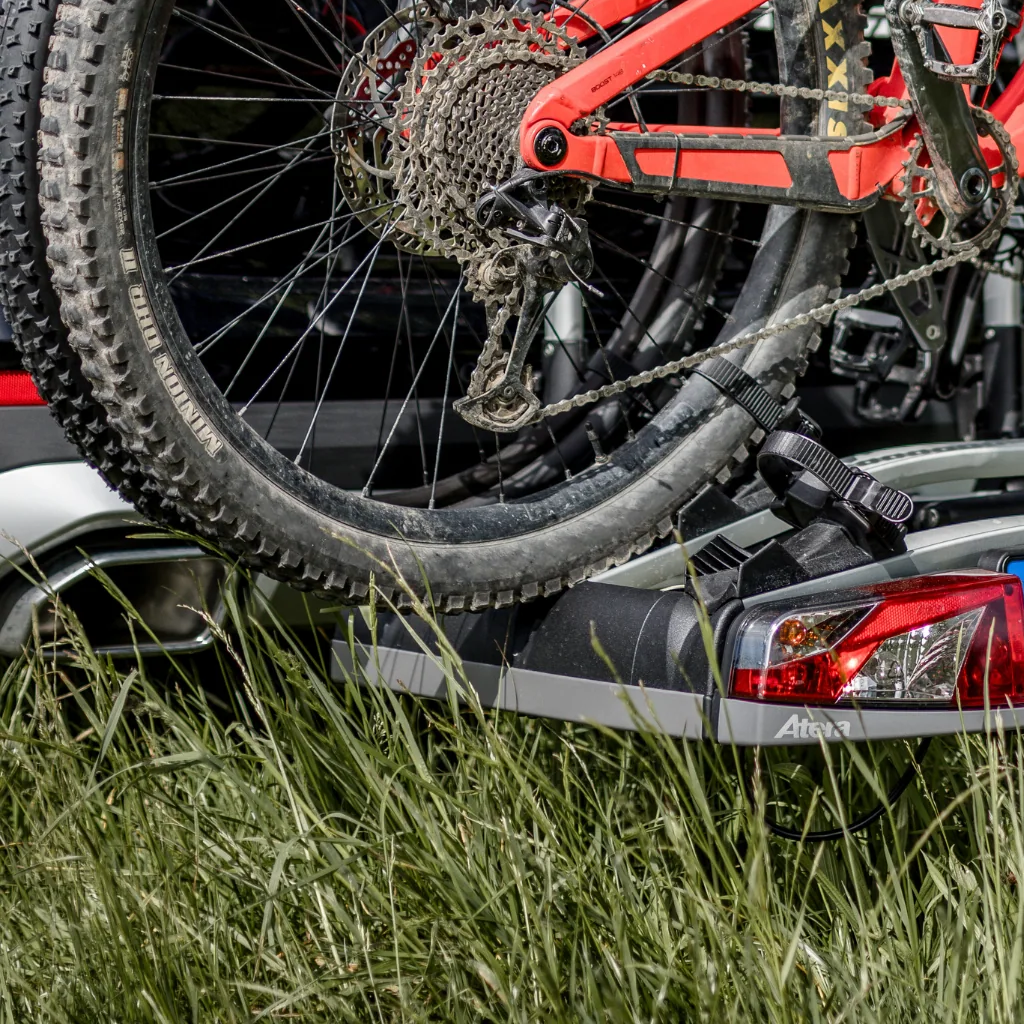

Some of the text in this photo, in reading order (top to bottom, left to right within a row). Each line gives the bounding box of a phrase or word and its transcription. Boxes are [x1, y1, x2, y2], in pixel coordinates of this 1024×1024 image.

[591, 75, 612, 93] BOOST
[128, 283, 162, 352] DHR
[153, 352, 223, 458] MINION
[774, 714, 851, 739] Atera
